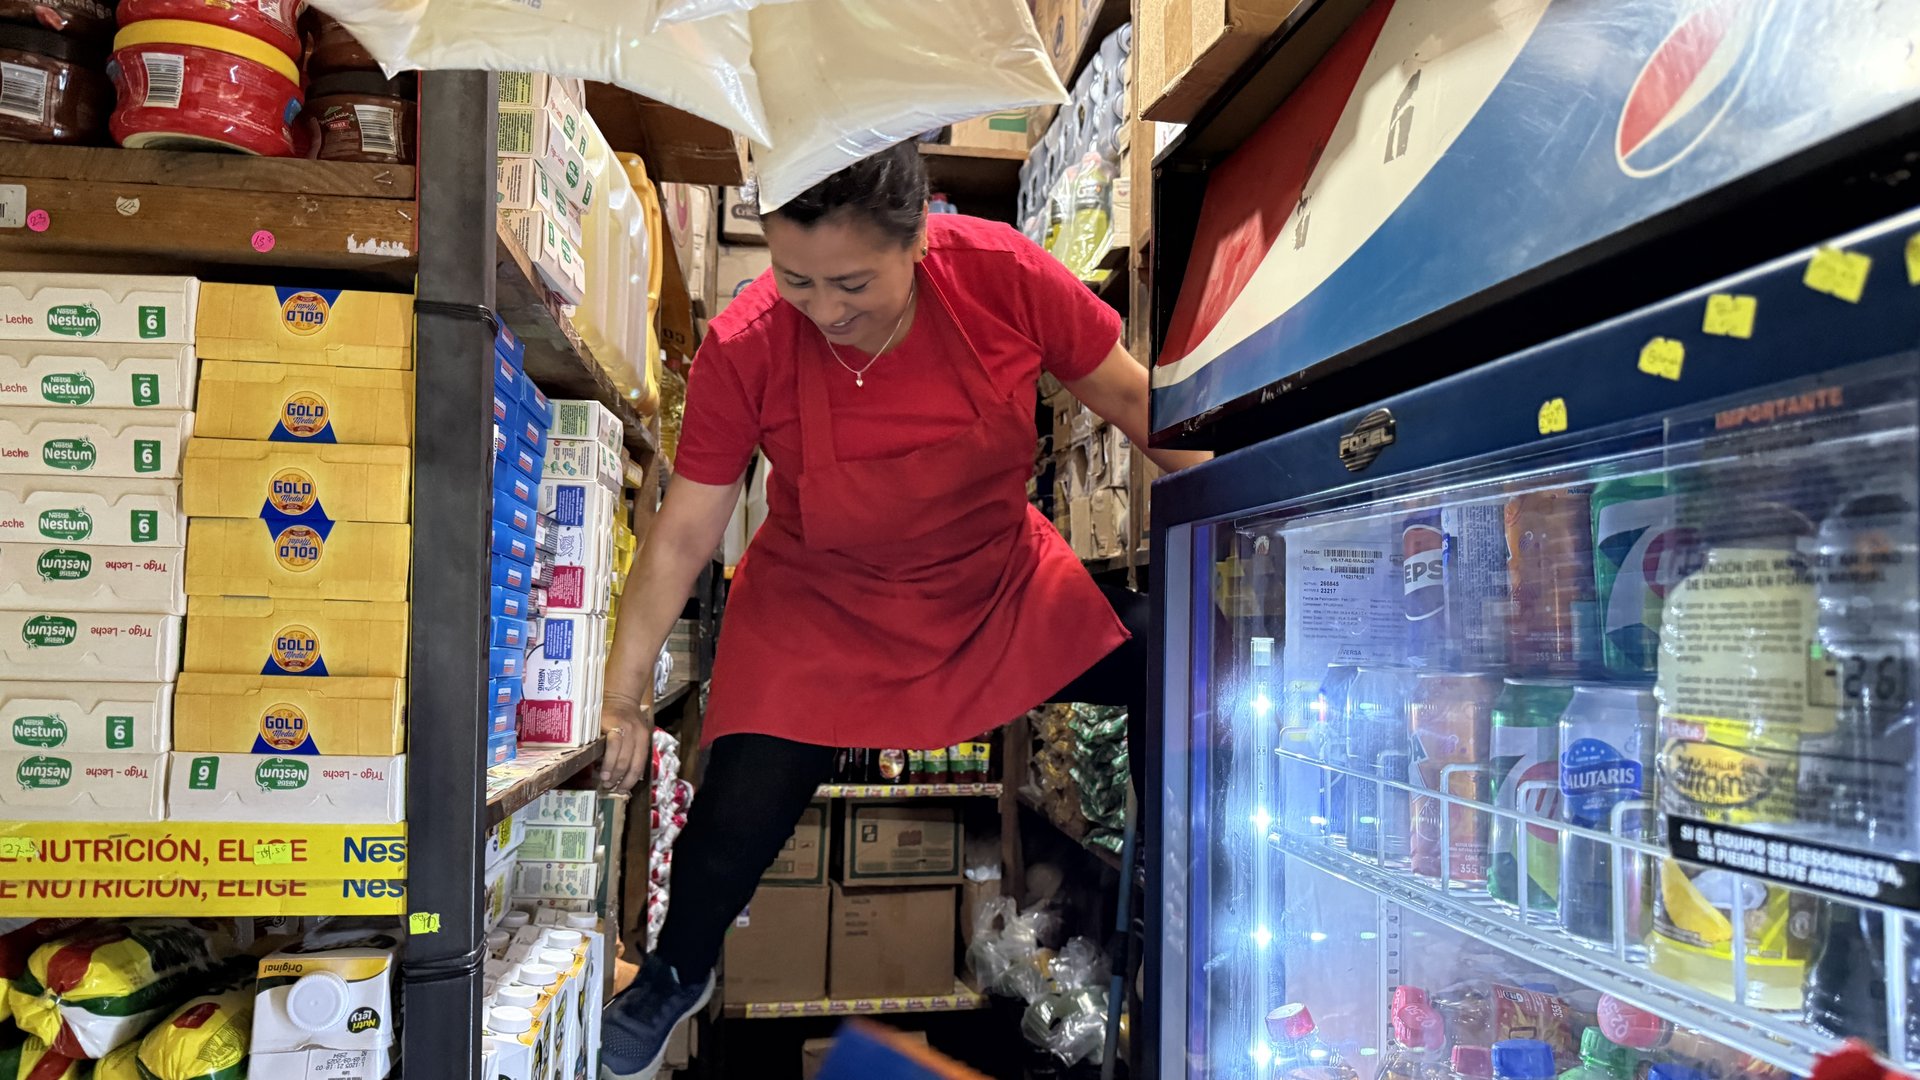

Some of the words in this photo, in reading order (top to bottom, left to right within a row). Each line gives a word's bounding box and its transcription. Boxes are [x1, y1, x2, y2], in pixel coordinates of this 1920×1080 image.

[5, 314, 34, 325] Leche
[49, 314, 97, 327] Nestum
[146, 315, 158, 330] 6
[286, 310, 324, 325] GOLD
[43, 382, 91, 395] Nestum
[140, 382, 152, 398] 6
[286, 402, 325, 417] GOLD
[1714, 386, 1844, 429] IMPORTANTE
[1, 447, 30, 458] Leche
[44, 447, 92, 461] Nestum
[142, 448, 153, 464] 6
[273, 480, 312, 495] GOLD
[40, 517, 88, 531] Nestum
[138, 518, 150, 534] 6
[280, 546, 318, 560] GOLD
[42, 558, 90, 572] Nestum
[105, 560, 133, 571] Leche
[143, 560, 168, 573] Trigo
[26, 625, 75, 638] Nestum
[91, 626, 118, 637] Leche
[128, 624, 153, 638] Trigo
[277, 637, 315, 651] GOLD
[265, 715, 303, 730] GOLD
[14, 725, 63, 738] Nestum
[114, 725, 126, 740] 6
[21, 766, 70, 779] Nestum
[86, 768, 113, 778] Leche
[124, 765, 148, 779] Trigo
[260, 768, 307, 781] Nestum
[322, 769, 350, 780] Leche
[361, 768, 384, 781] Trigo
[1679, 823, 1695, 842] SI
[1695, 827, 1713, 845] EL
[1713, 830, 1767, 857] EQUIPO
[1767, 840, 1789, 860] SE
[27, 834, 209, 866] NUTRICIÓN,
[219, 838, 308, 862] ELE
[1459, 863, 1478, 874] 355
[1697, 843, 1716, 862] SE
[1716, 847, 1767, 874] PIERDE
[1767, 857, 1808, 882] ESTE
[1807, 867, 1880, 897] AHORRO
[217, 880, 308, 898] ELIGE
[264, 962, 303, 974] Original
[350, 1009, 373, 1023] Lety
[352, 1019, 377, 1032] Nutri
